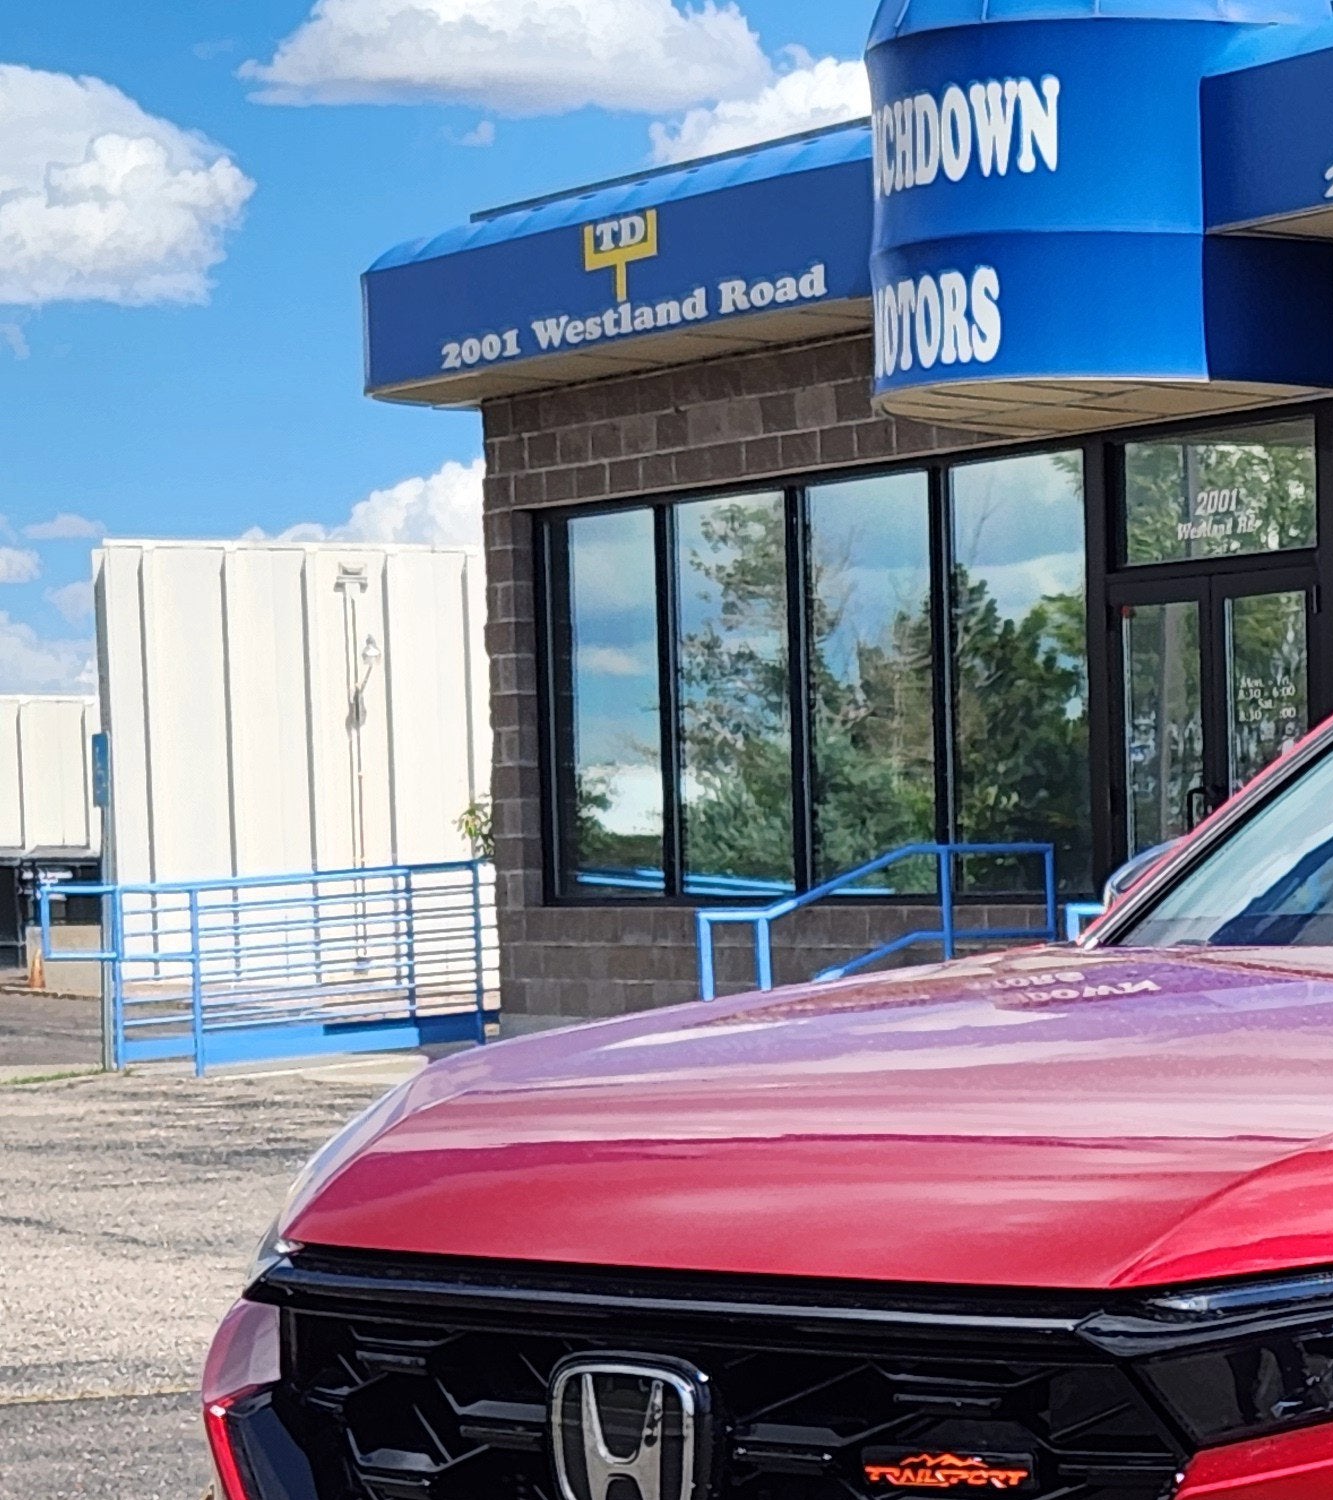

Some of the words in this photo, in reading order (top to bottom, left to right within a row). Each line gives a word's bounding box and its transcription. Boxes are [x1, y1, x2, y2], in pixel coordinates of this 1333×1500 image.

[596, 215, 645, 251] TD
[441, 329, 521, 370] 2001
[531, 286, 709, 350] Westland
[718, 264, 828, 315] Road
[1194, 487, 1238, 515] 2001
[864, 1465, 1029, 1489] TRAILSPORT
